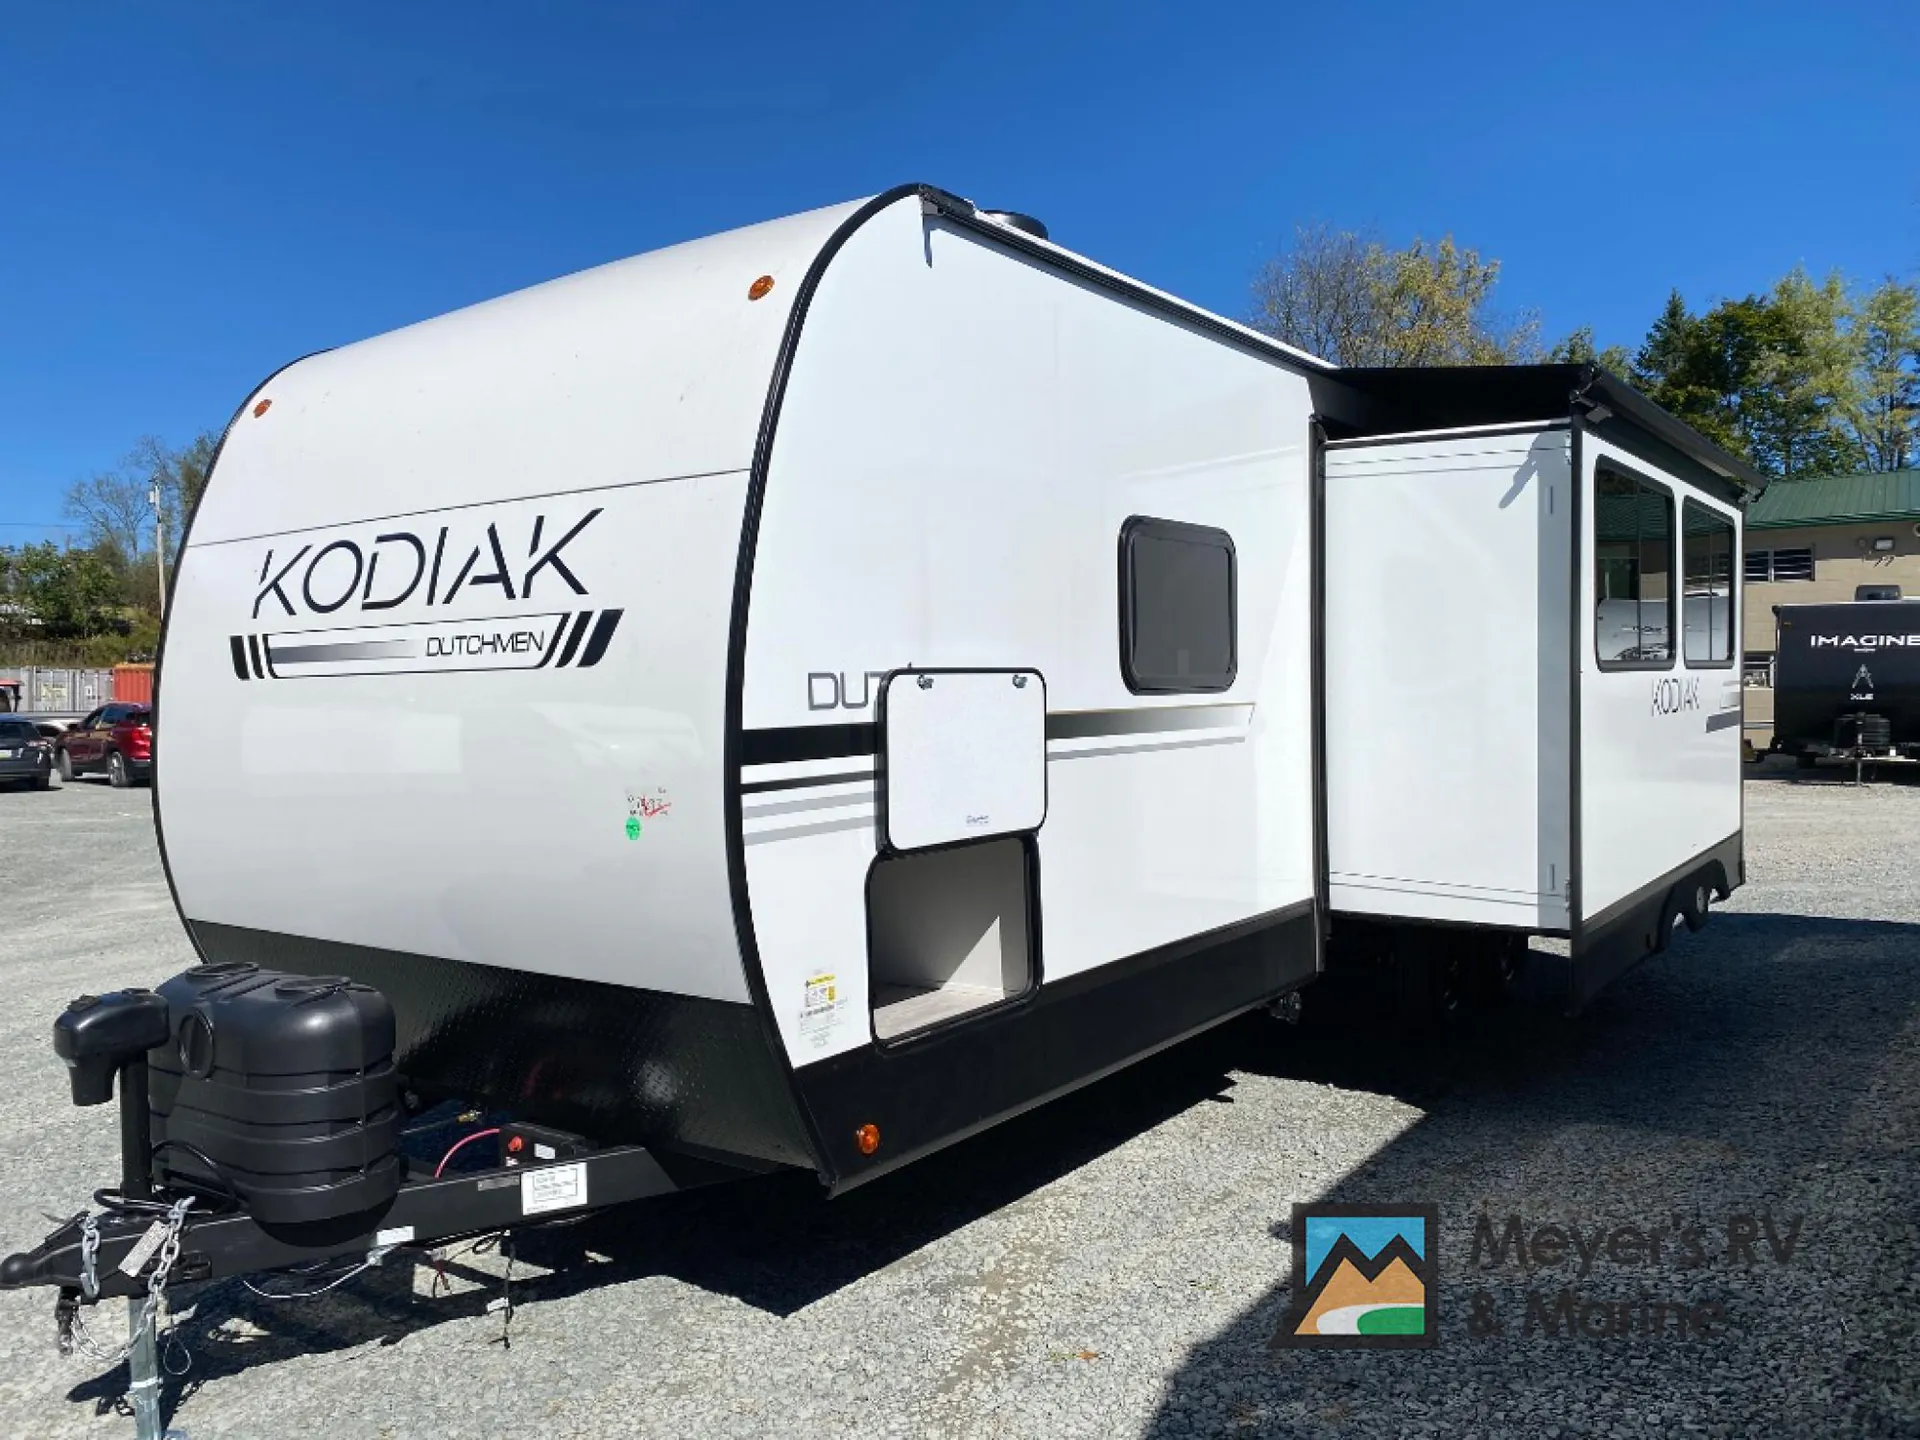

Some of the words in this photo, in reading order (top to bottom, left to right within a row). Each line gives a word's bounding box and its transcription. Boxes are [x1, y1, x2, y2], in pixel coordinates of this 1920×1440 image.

[252, 508, 604, 619] KODIAK
[427, 630, 544, 656] DUTCHMEN
[1810, 634, 1920, 647] IMAGINE
[1652, 677, 1699, 717] KODIAK
